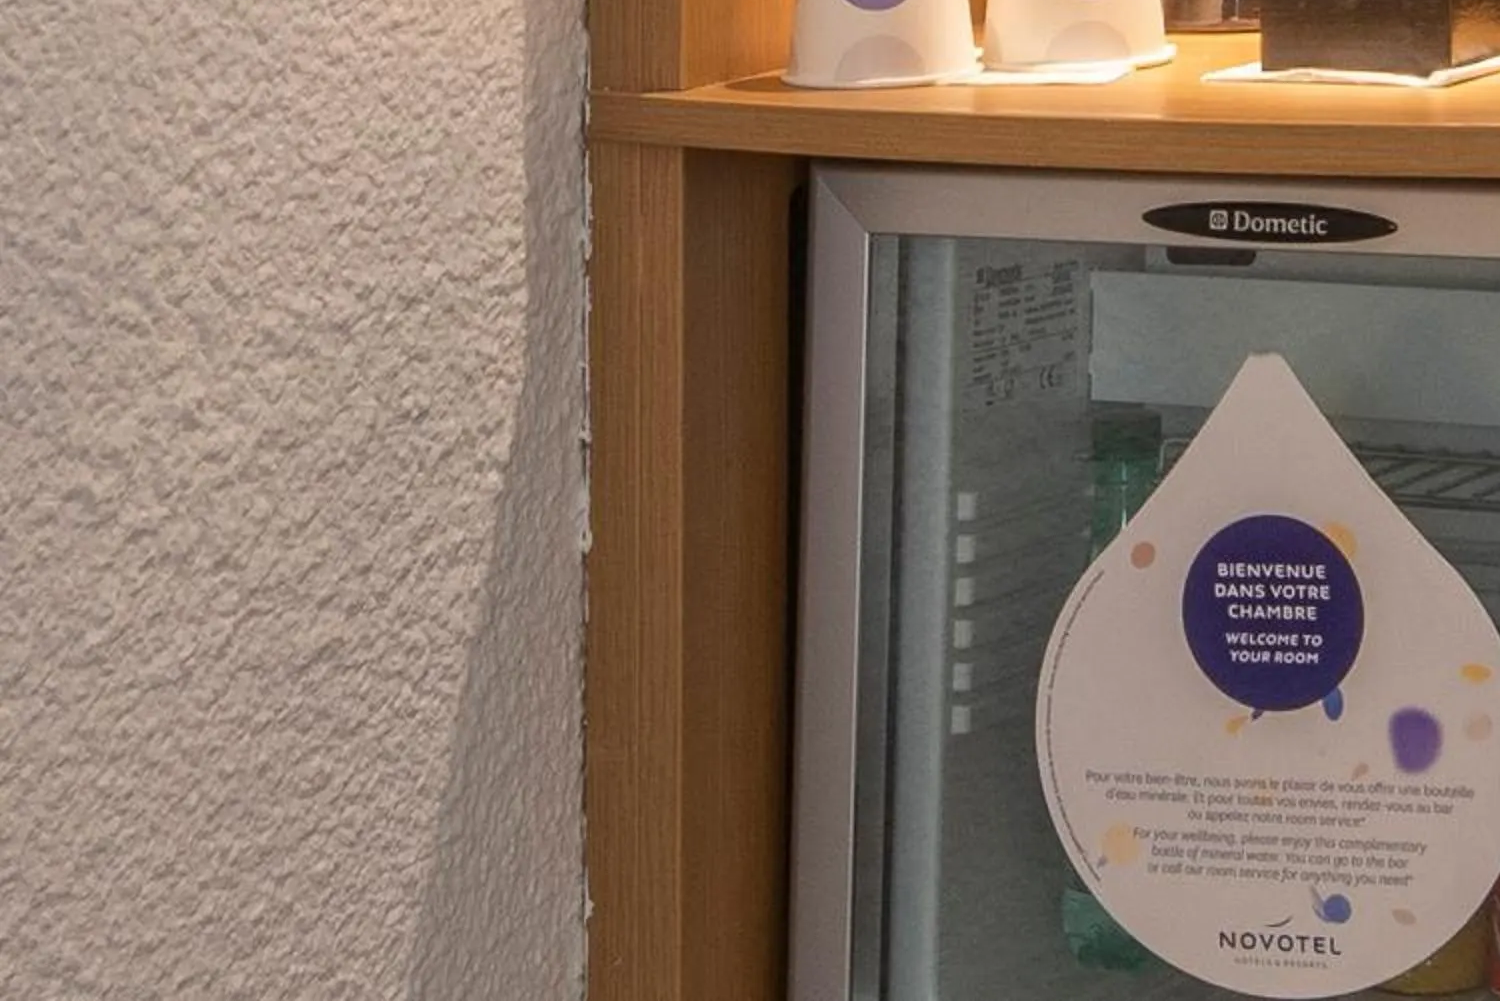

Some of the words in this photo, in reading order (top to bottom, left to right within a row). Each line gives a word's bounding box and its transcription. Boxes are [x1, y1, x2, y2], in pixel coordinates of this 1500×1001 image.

[1233, 211, 1329, 236] Dometic
[1217, 562, 1327, 580] BIENVENUE
[1214, 583, 1266, 599] DANS
[1269, 584, 1331, 600] VOTRE
[1228, 603, 1318, 621] CHAMBRE
[1225, 632, 1299, 647] WELCOME
[1301, 635, 1323, 647] TO
[1229, 649, 1272, 664] YOUR
[1273, 651, 1320, 665] ROOM
[1085, 769, 1111, 783] Pour
[1114, 772, 1144, 786] votre
[1319, 779, 1335, 793] de
[1338, 782, 1366, 794] vous
[1133, 826, 1151, 840] For
[1153, 828, 1179, 843] your
[1218, 930, 1343, 956] NOVOTEL
